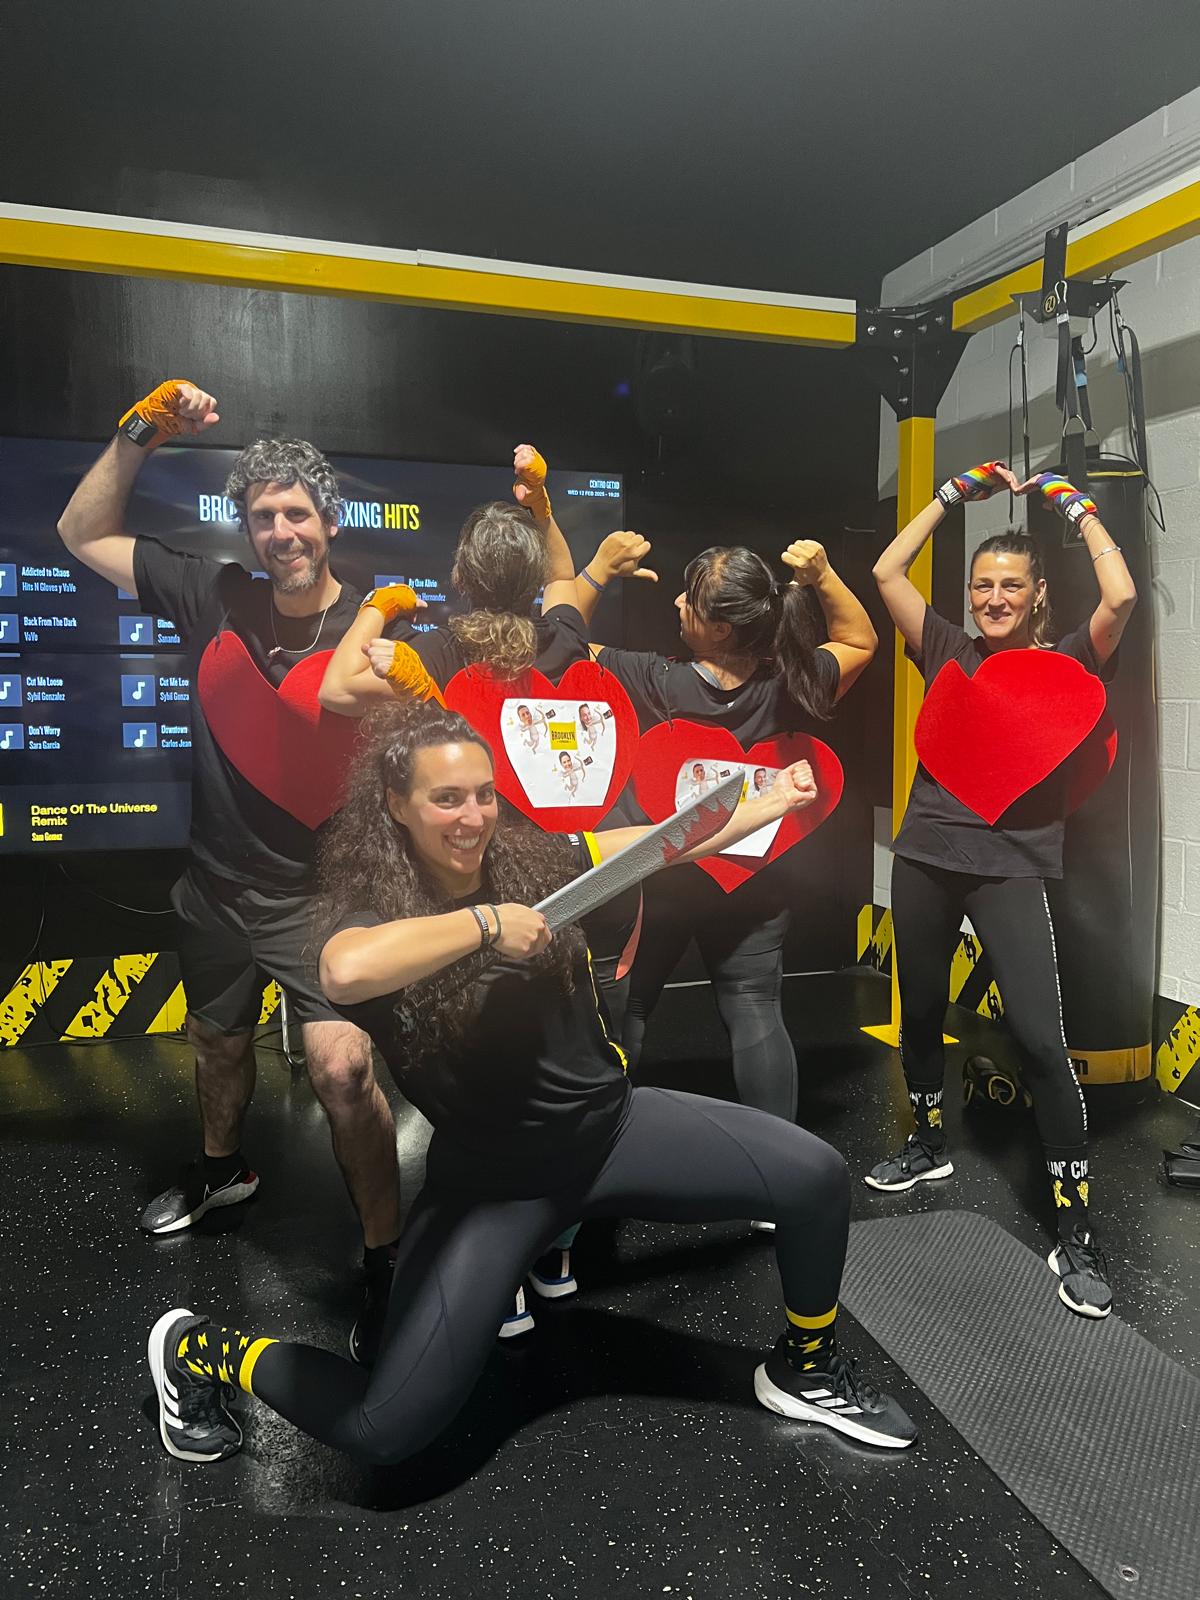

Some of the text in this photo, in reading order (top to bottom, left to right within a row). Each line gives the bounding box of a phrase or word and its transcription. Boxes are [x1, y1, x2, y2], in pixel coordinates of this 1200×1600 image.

[384, 503, 420, 531] HITS
[21, 566, 70, 578] Addicted to Chaos
[39, 582, 58, 592] Gloves
[23, 617, 77, 627] Back From The Dark
[26, 676, 64, 687] Cut Me Loose
[159, 677, 189, 687] Cut Me Loo
[173, 692, 190, 701] Gonza
[44, 726, 61, 737] Worry
[160, 724, 188, 734] Downtown
[551, 730, 576, 741] BROOKLYN
[29, 740, 42, 750] Sara
[161, 739, 192, 749] Carlos Jean
[31, 802, 158, 816] Dance Of The Universe
[31, 816, 68, 826] Remix
